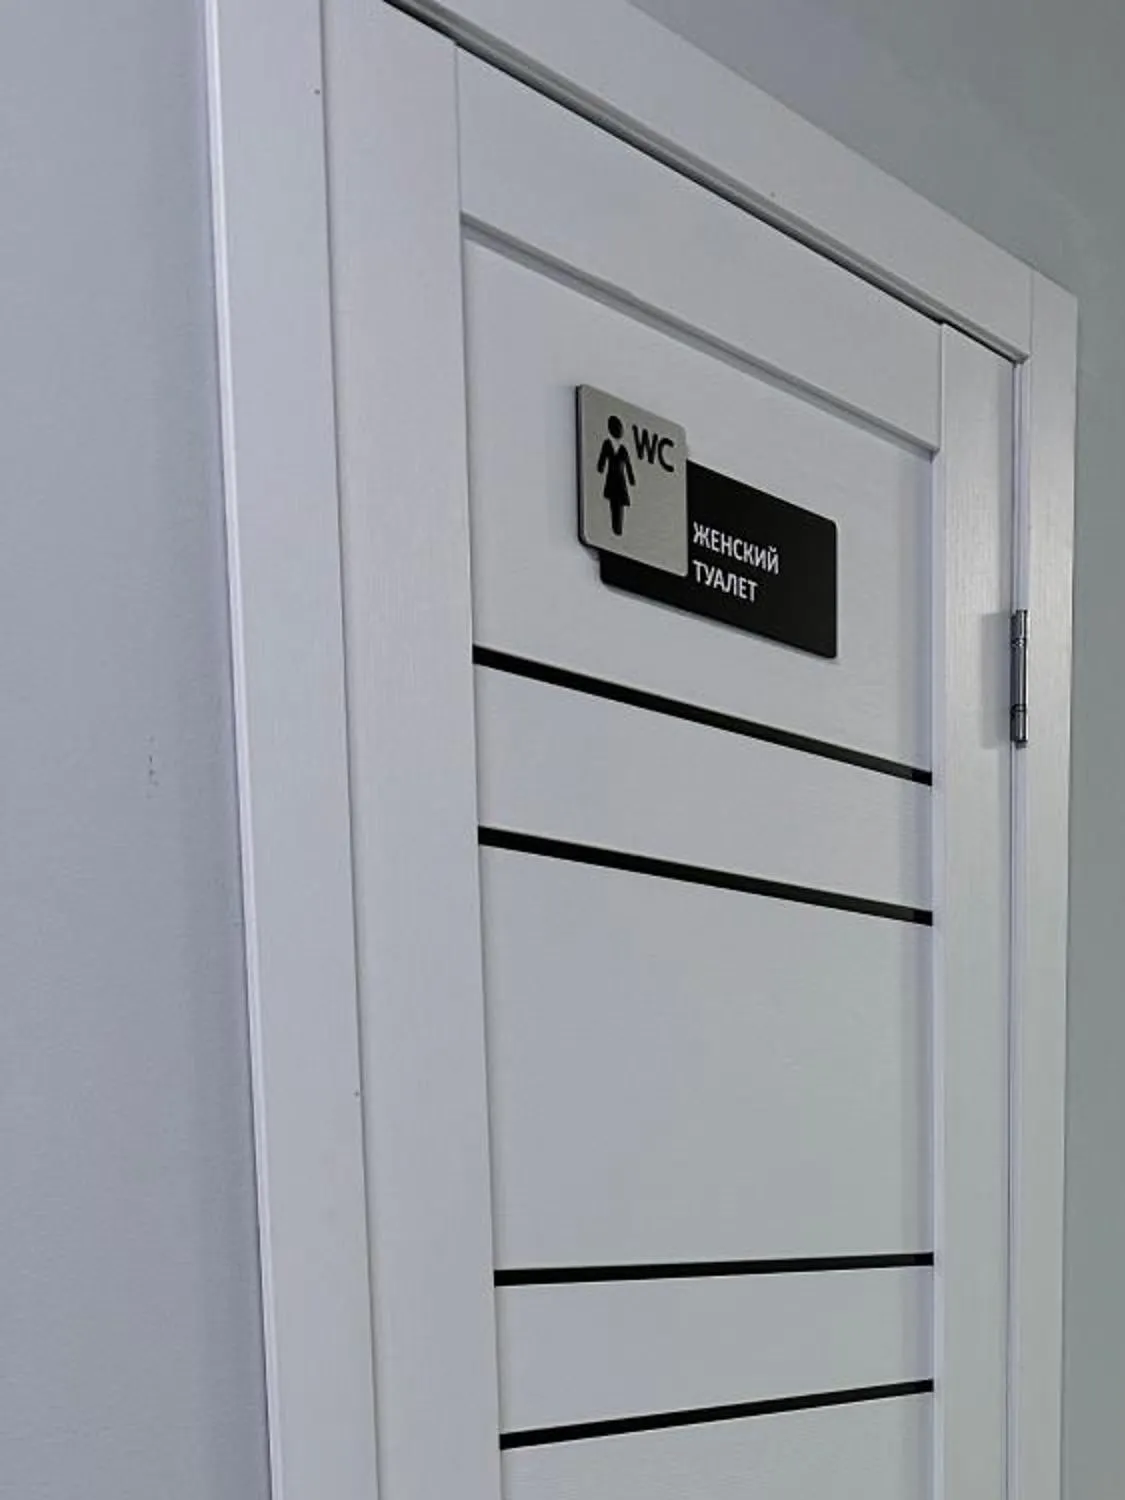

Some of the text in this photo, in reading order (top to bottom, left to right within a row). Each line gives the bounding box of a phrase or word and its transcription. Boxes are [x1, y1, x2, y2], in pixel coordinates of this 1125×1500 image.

[632, 424, 674, 472] WC
[693, 521, 779, 575] ЖЕНСКИЙ
[693, 560, 758, 602] ТУАЛЕТ
